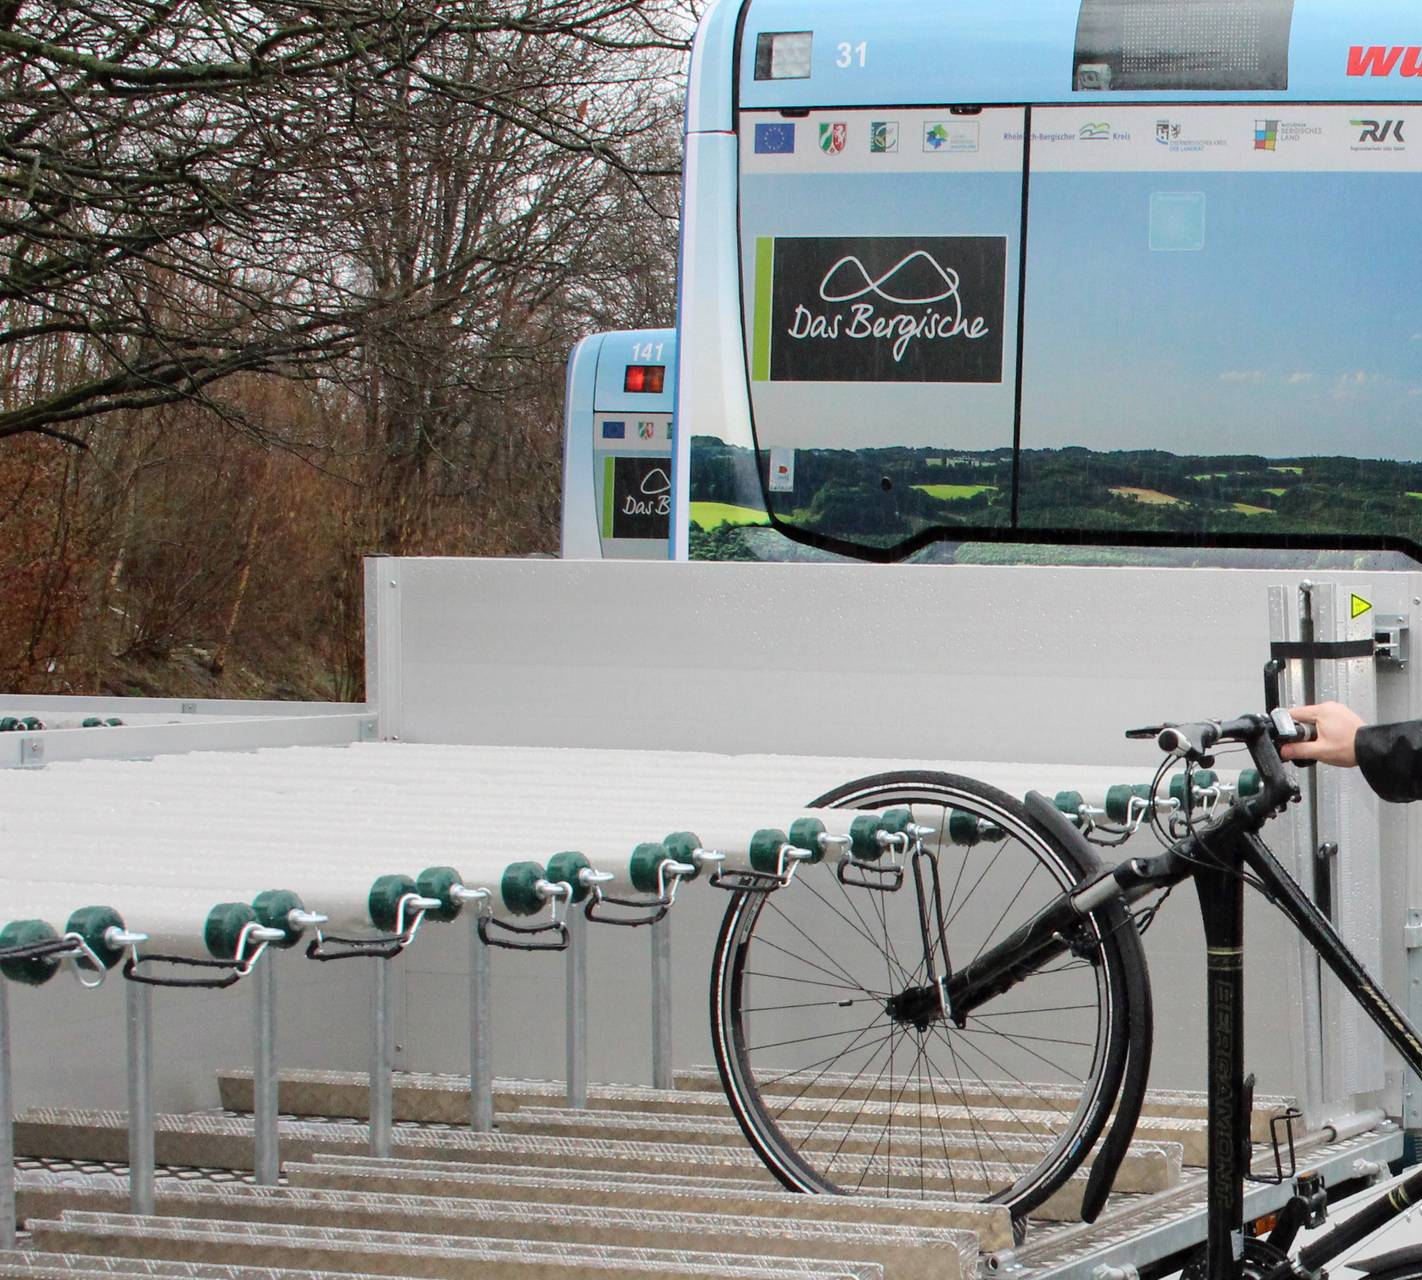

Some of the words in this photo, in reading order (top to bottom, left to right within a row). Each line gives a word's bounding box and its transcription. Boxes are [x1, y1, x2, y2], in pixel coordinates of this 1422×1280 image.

[836, 41, 867, 68] 31
[788, 303, 843, 339] Das
[845, 303, 989, 362] Bergische
[632, 343, 663, 362] 141
[622, 494, 653, 515] Das
[1214, 979, 1234, 1210] BERGAMONT
